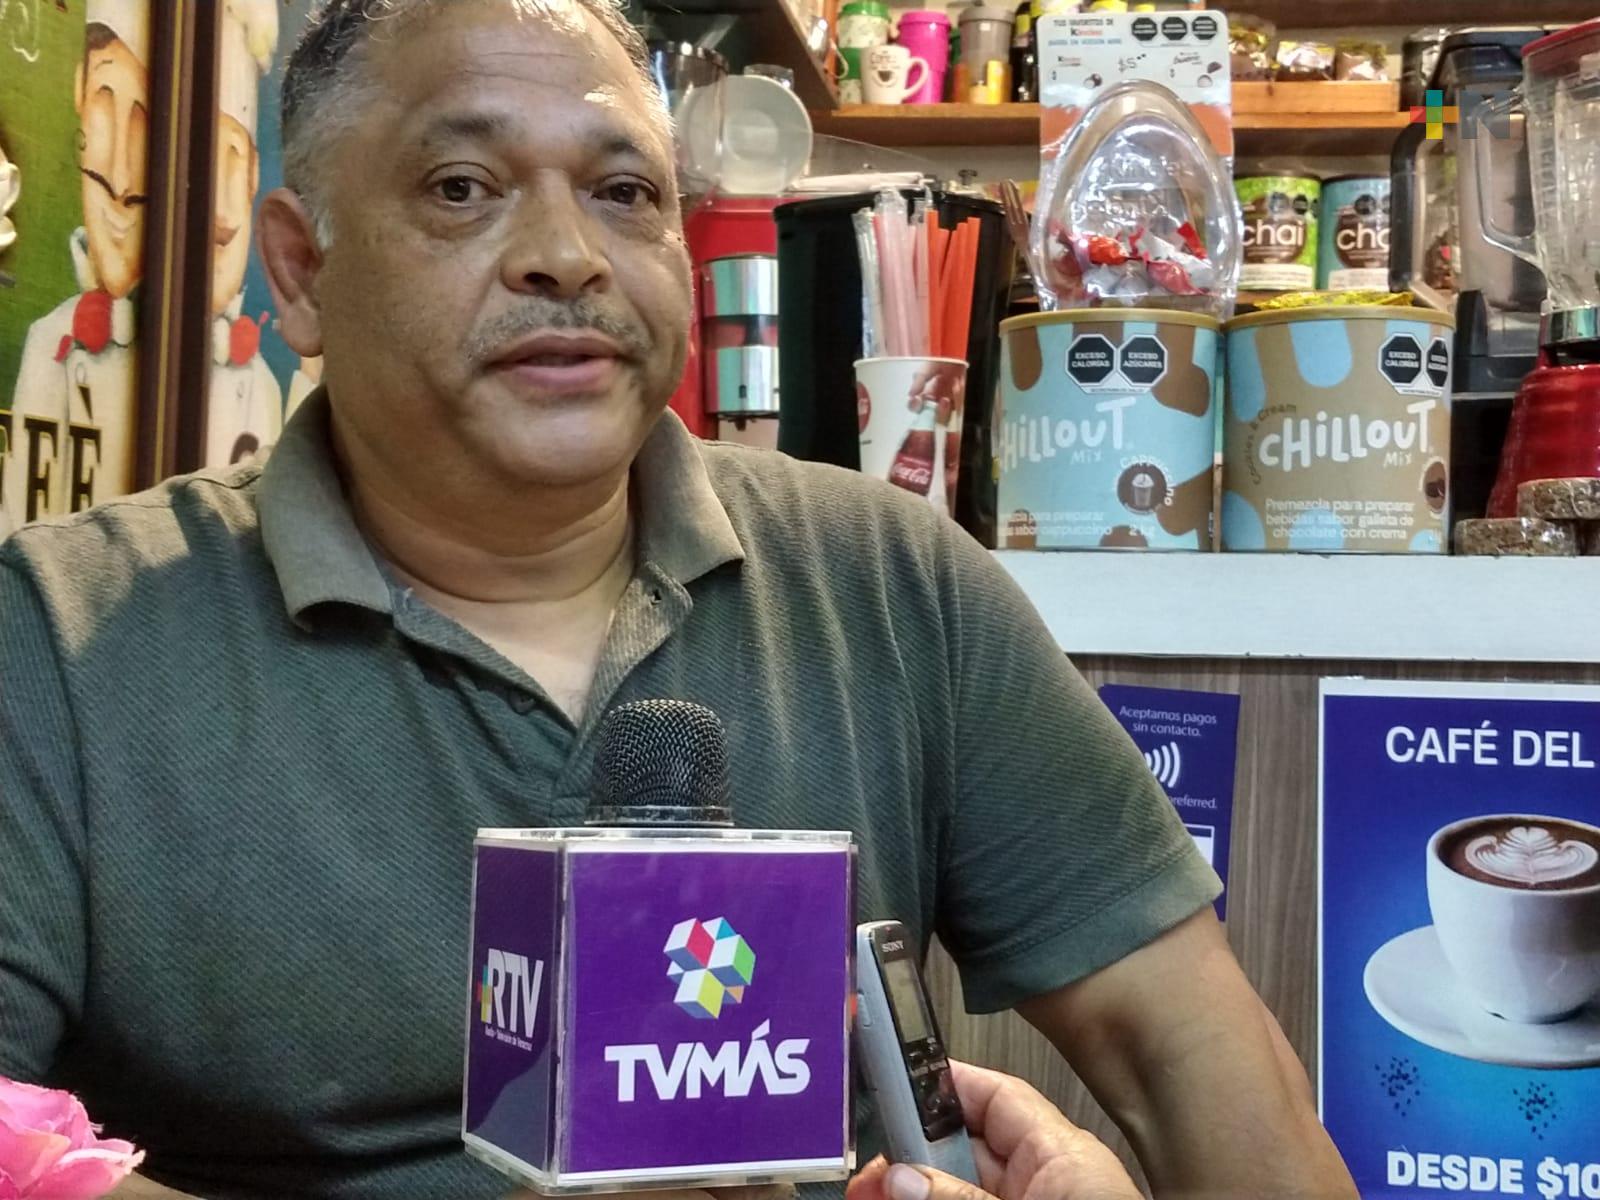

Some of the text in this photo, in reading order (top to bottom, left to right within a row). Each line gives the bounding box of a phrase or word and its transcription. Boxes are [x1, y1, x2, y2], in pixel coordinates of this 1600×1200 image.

[1240, 219, 1304, 247] chai
[1075, 351, 1107, 360] EXCESO
[1127, 351, 1159, 360] EXCESO
[1265, 498, 1416, 515] Premezcla para preparar
[1399, 515, 1415, 527] de
[1339, 527, 1366, 538] con
[1368, 527, 1408, 539] crema
[1118, 705, 1217, 726] Aceptamos pagos
[1132, 721, 1202, 738] sin contacto.
[1385, 719, 1595, 768] CAFÉ DEL
[1170, 794, 1218, 810] referred.
[882, 940, 905, 953] SONY
[481, 947, 544, 1039] RTV
[604, 1018, 811, 1103] TVMÁS
[1387, 1150, 1525, 1195] DESDE
